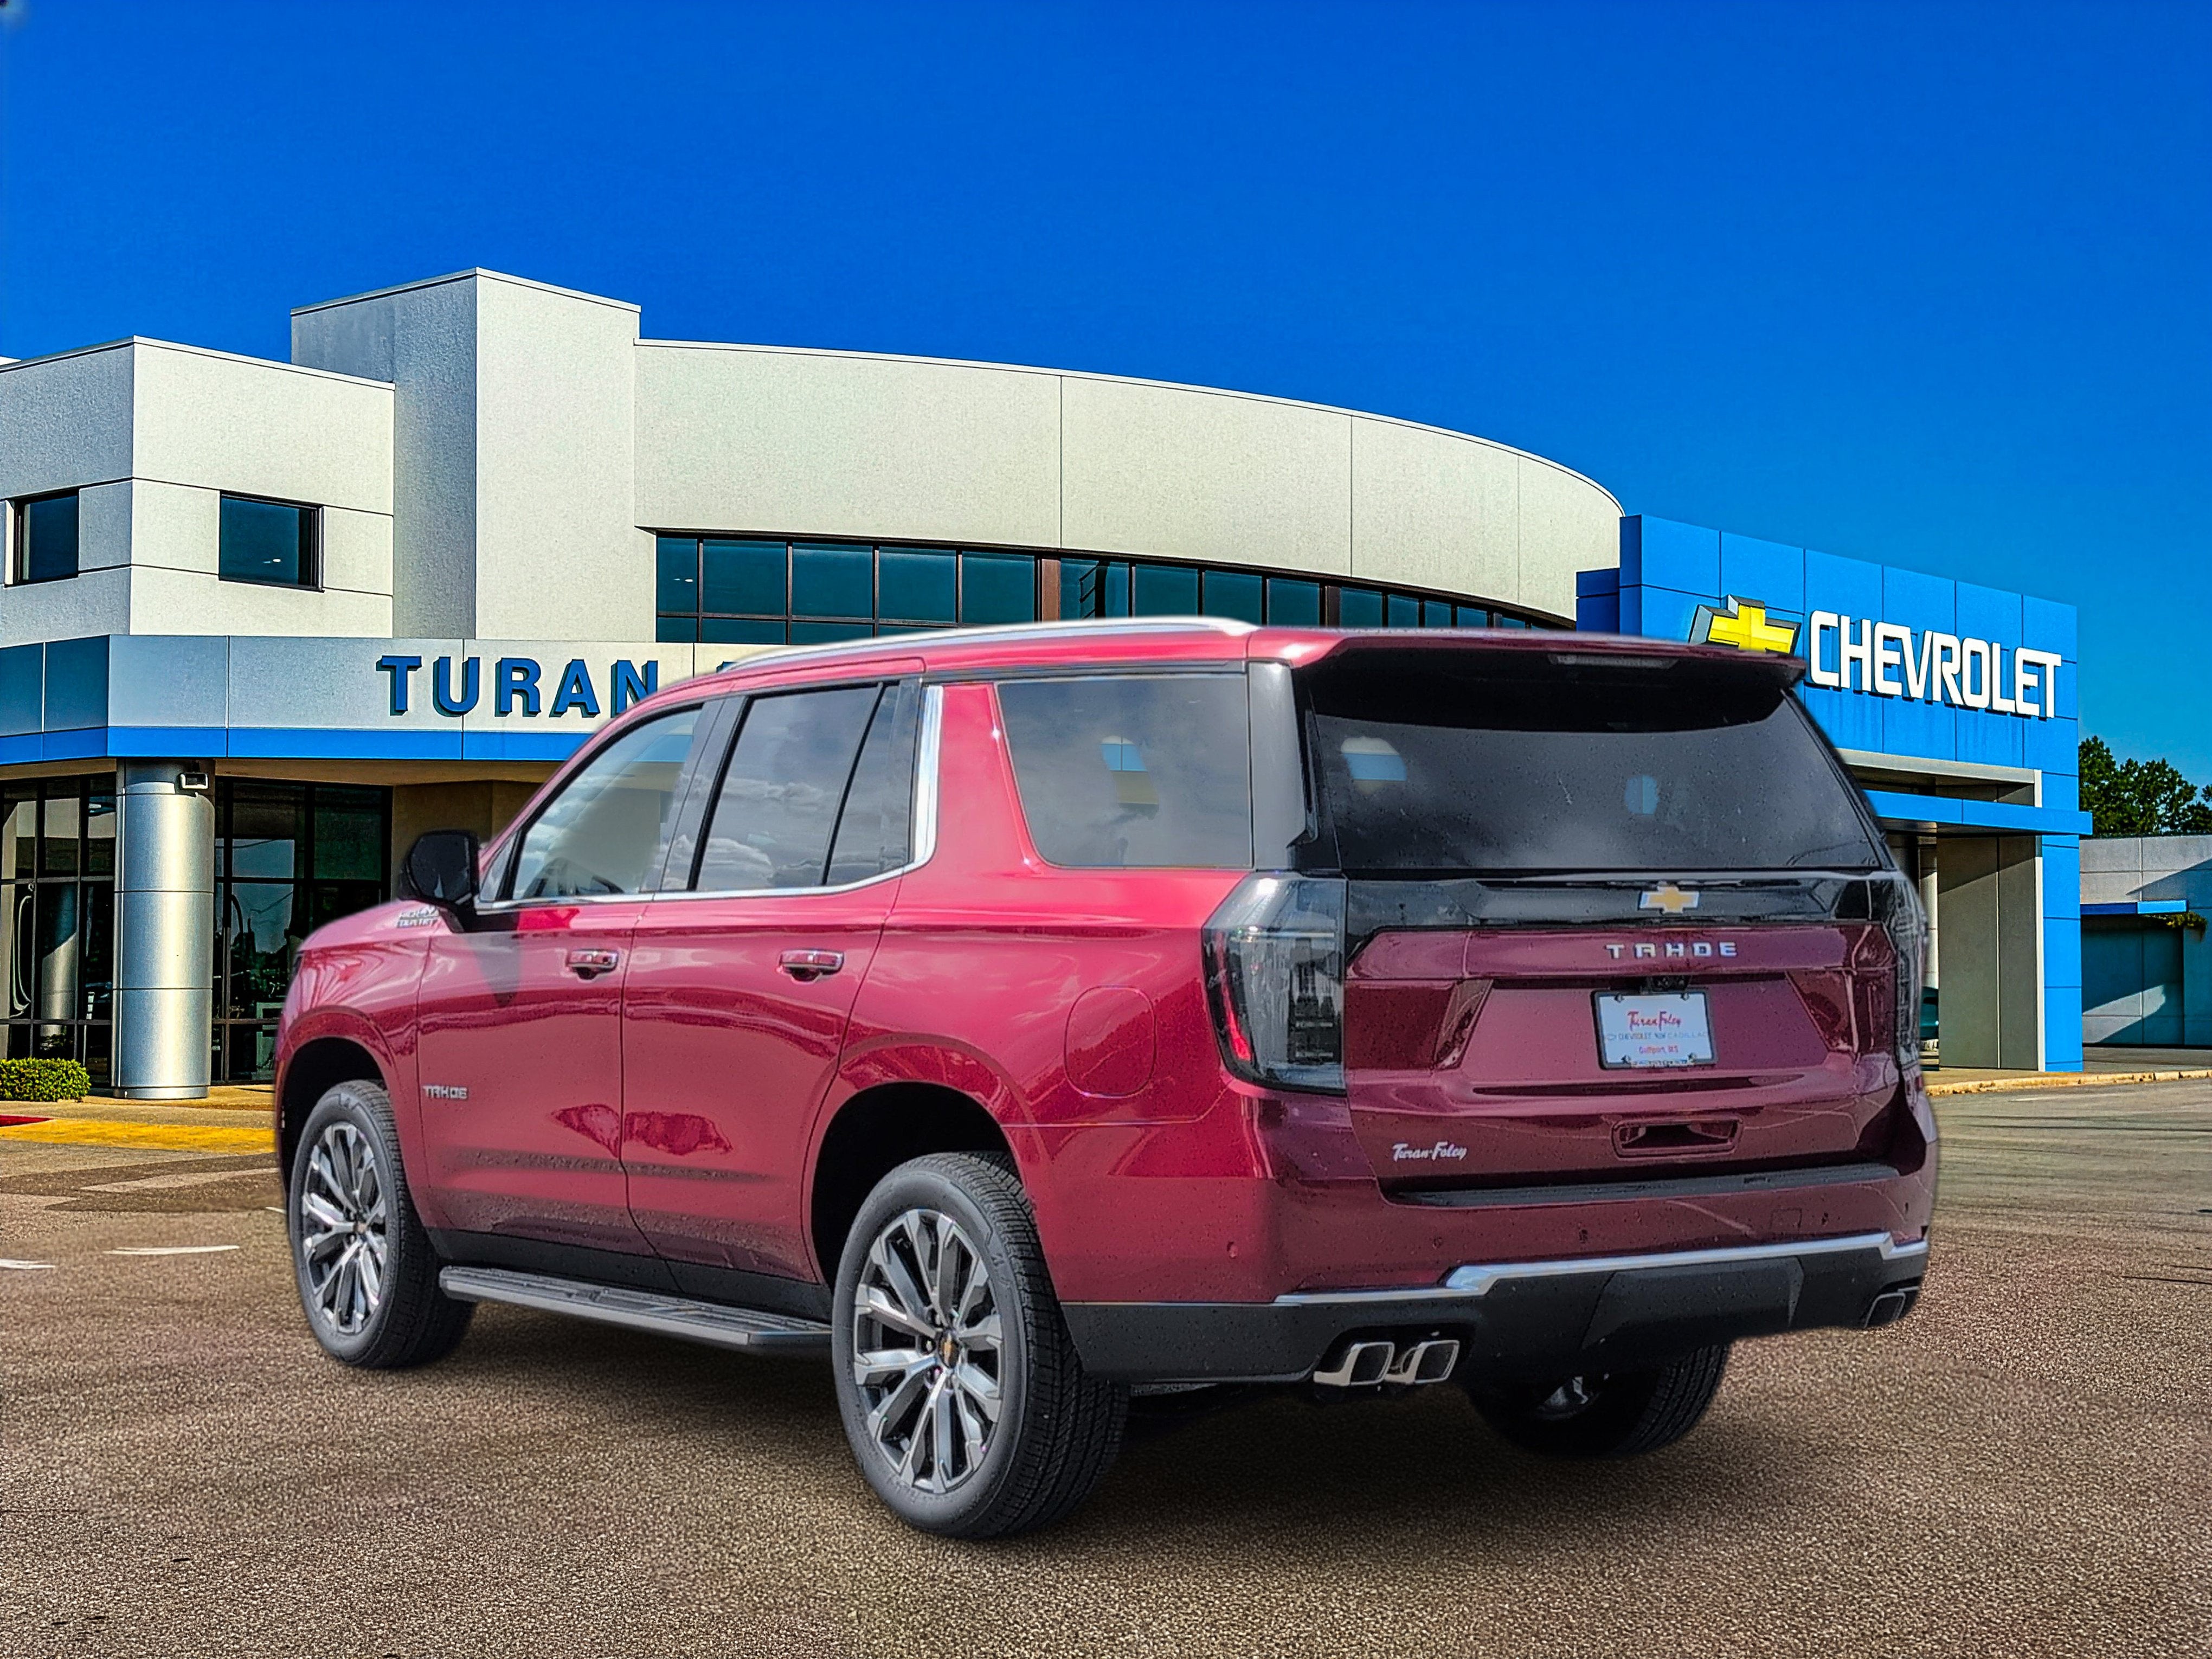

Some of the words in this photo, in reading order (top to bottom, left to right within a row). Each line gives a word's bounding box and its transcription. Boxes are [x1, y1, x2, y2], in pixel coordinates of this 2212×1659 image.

[1810, 610, 2062, 719] CHEVROLET
[376, 655, 659, 718] TURAN
[1605, 941, 1738, 959] TAHOE
[423, 1085, 468, 1100] TAHOE
